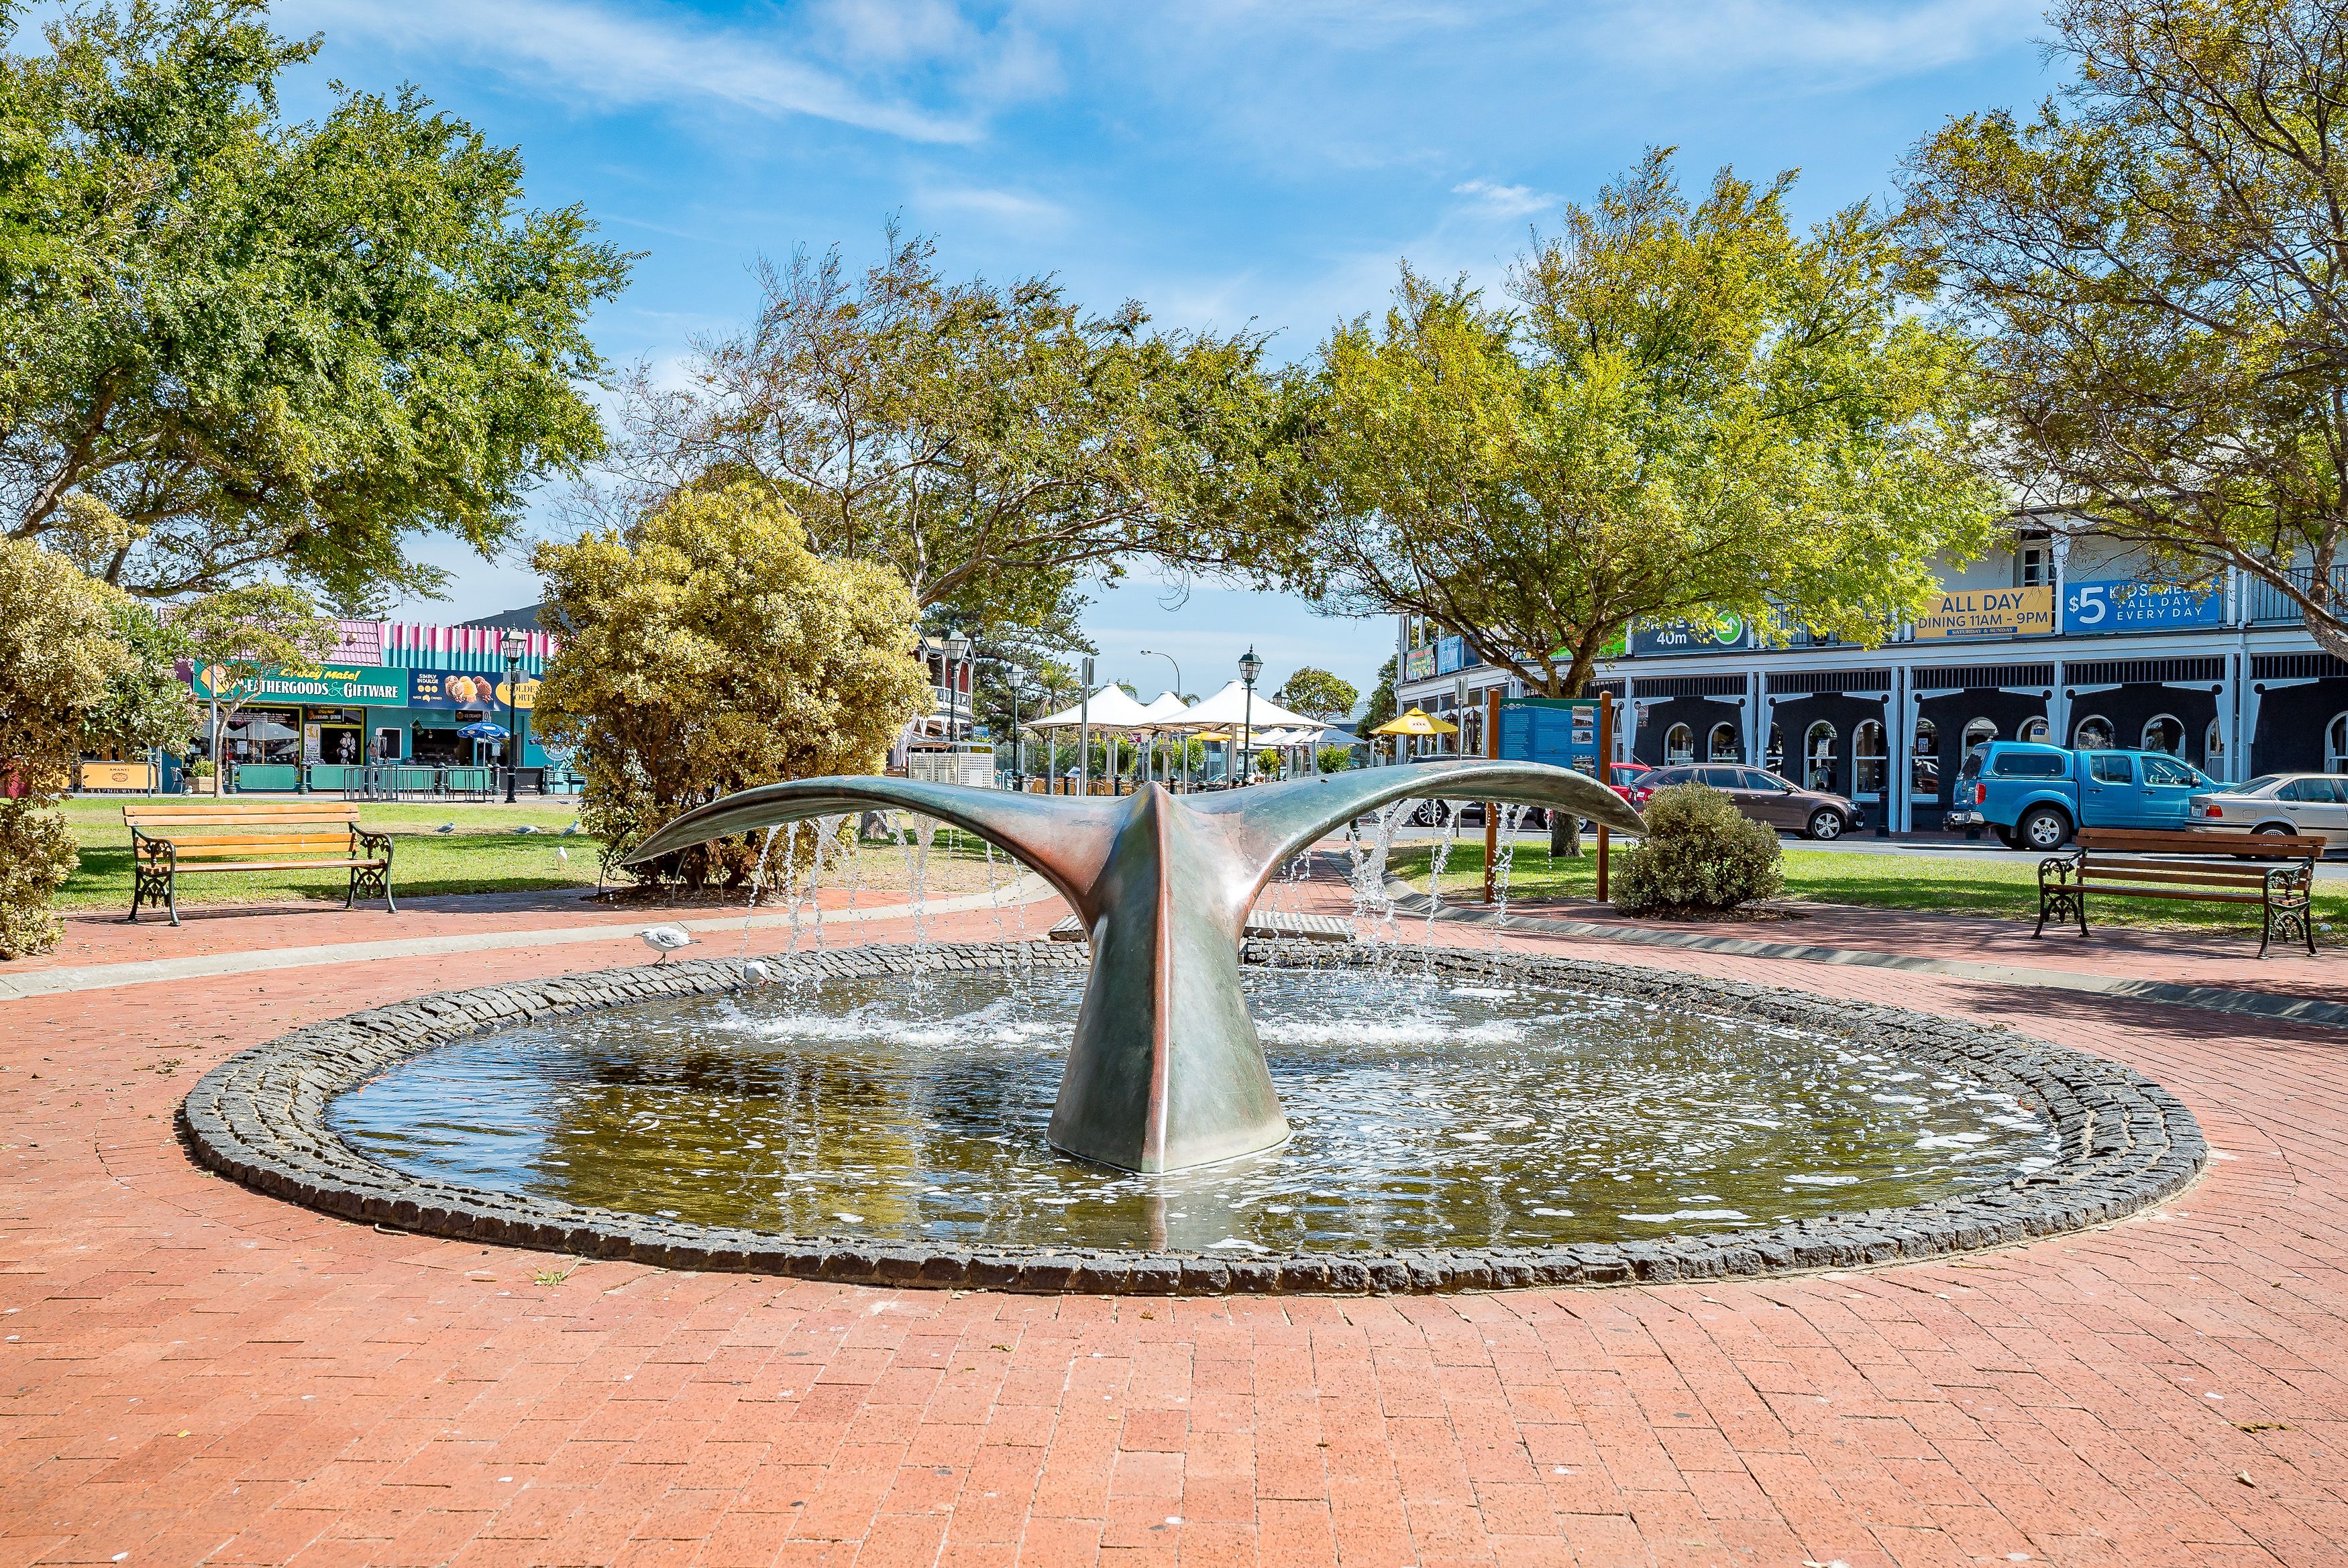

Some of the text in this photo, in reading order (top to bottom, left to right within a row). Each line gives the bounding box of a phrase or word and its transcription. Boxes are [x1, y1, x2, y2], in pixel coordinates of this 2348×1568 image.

[2109, 583, 2147, 599] KDS
[1941, 592, 2025, 614] ALL DAY
[2068, 586, 2106, 624] $5
[2128, 596, 2191, 608] ALL DAY
[1918, 615, 1966, 629] DINING
[1969, 614, 2003, 626] 11AM
[2017, 611, 2048, 624] 9PM
[2117, 607, 2202, 620] EVERY DAY
[1656, 630, 1687, 645] 40m
[280, 667, 362, 681] Ckey Mate!
[343, 682, 398, 698] GIFTWARE
[509, 693, 537, 702] ORT
